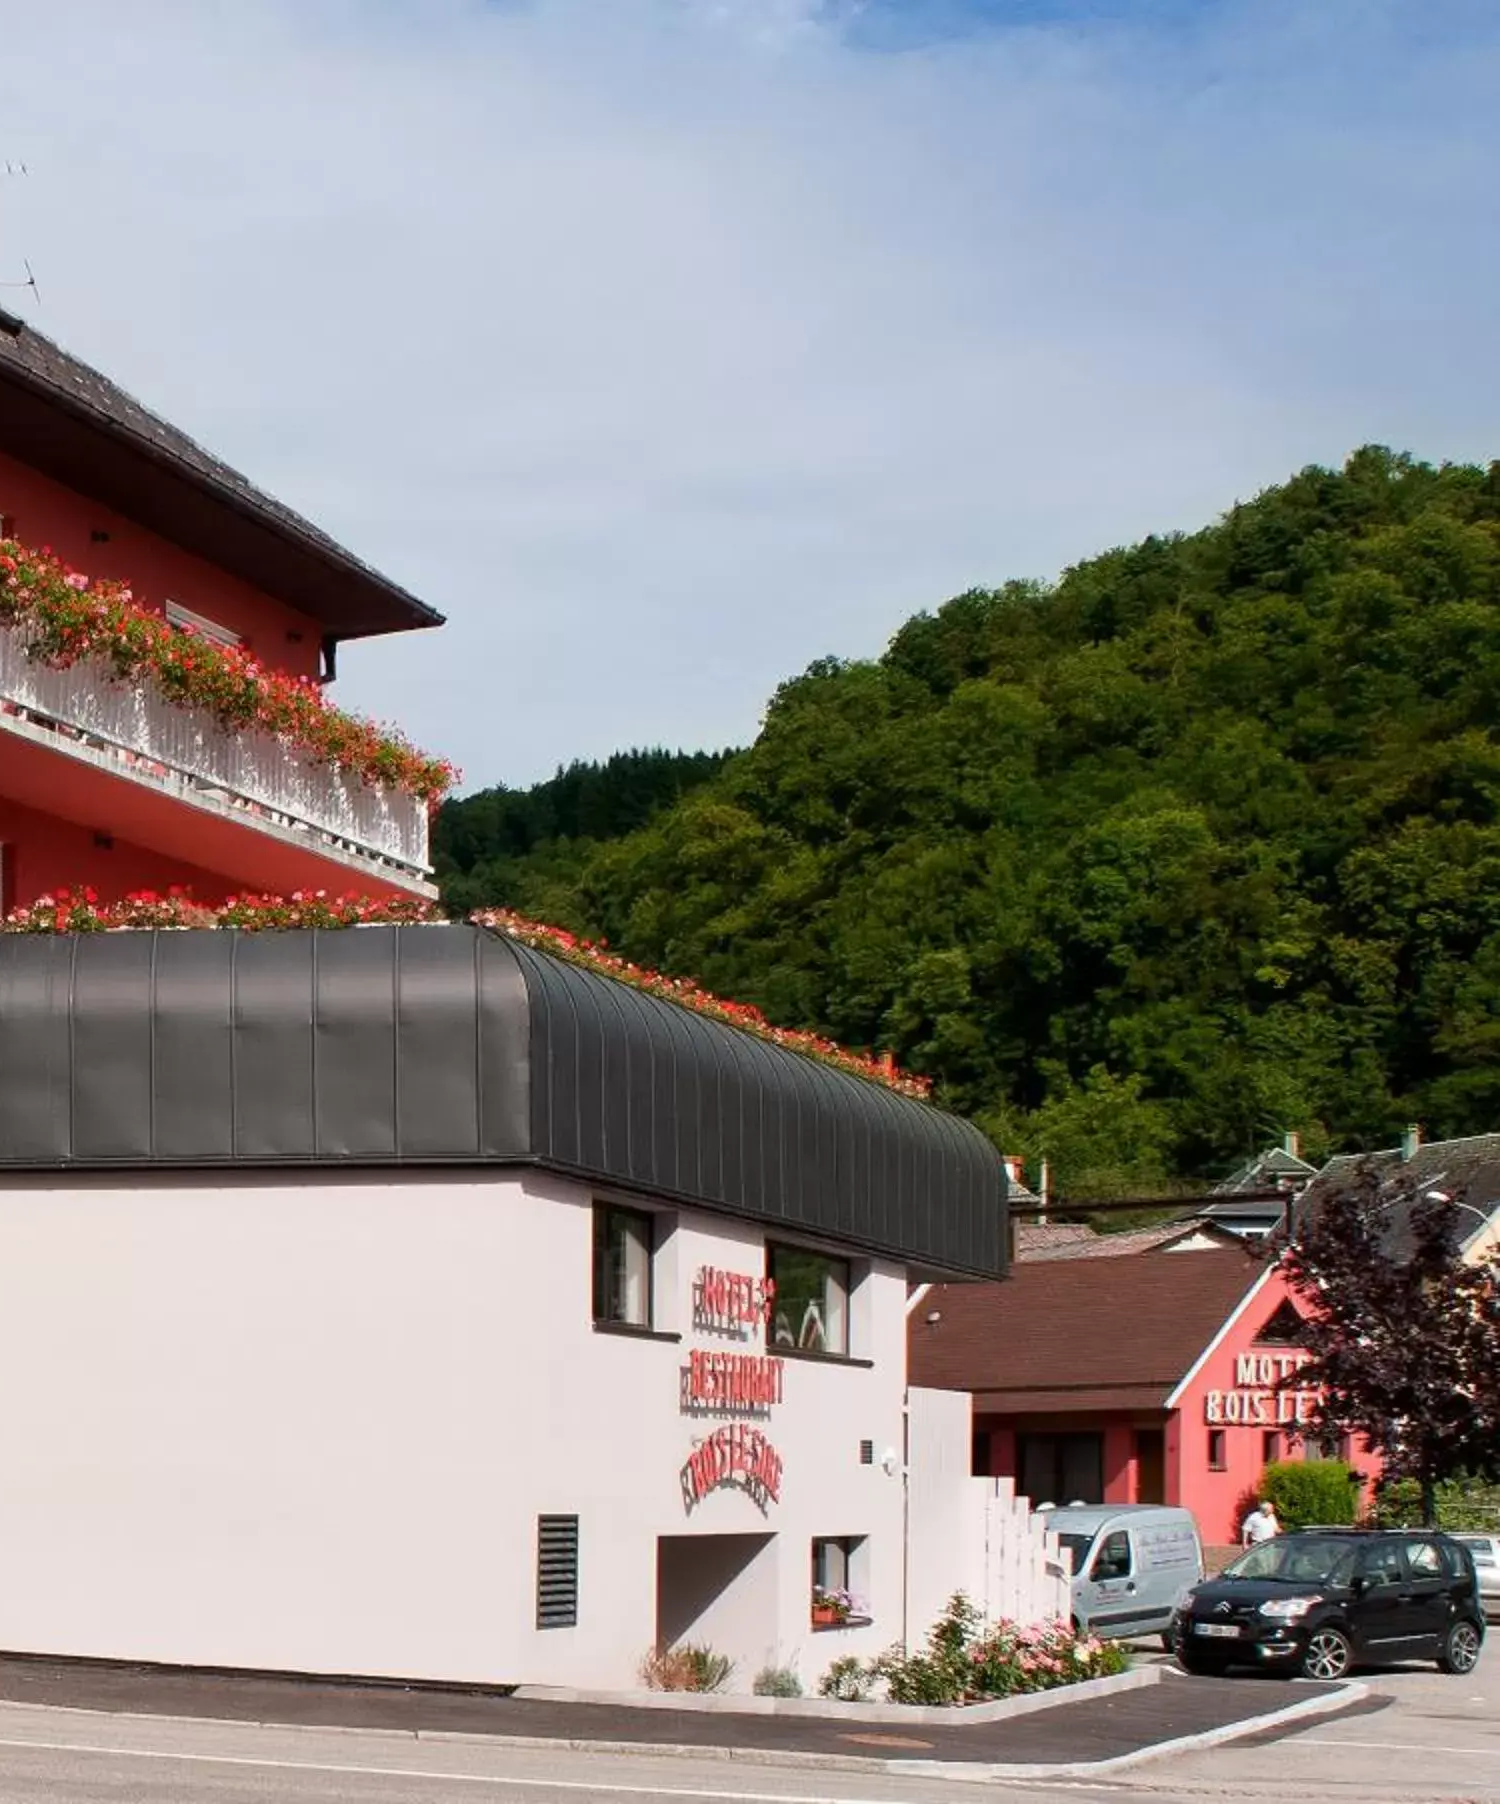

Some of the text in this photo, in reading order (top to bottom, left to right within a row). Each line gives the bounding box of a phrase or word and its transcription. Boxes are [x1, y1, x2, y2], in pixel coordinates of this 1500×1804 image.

[690, 1348, 785, 1404] RESTAURANT
[1206, 1388, 1266, 1423] BOIS
[1278, 1390, 1311, 1425] LE
